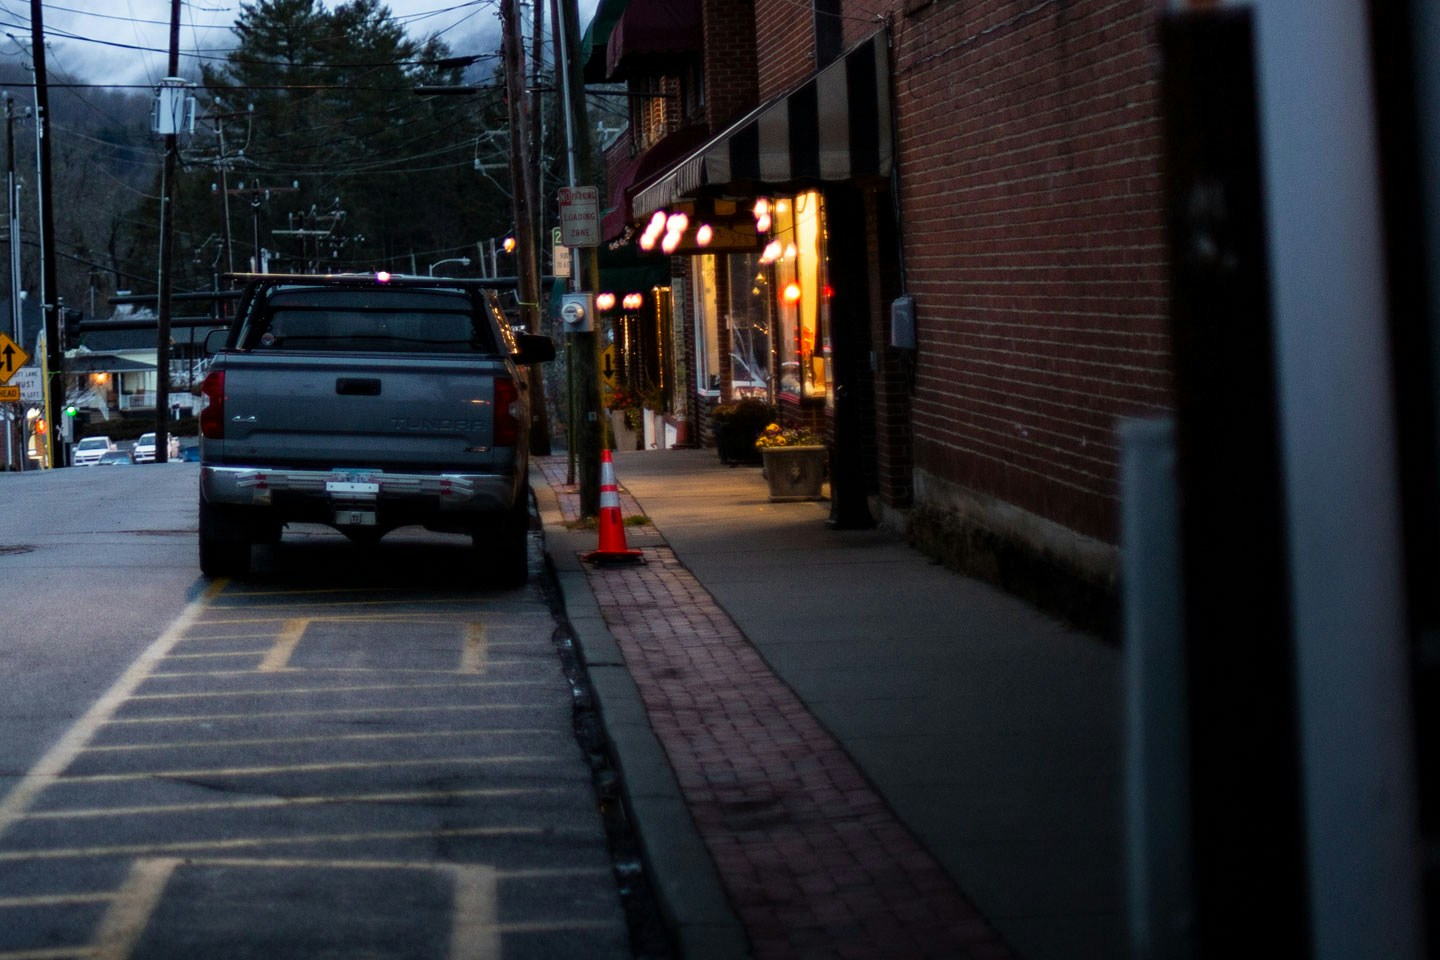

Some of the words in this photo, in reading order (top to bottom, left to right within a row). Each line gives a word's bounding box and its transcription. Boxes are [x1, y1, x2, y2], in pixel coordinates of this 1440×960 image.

[559, 191, 571, 203] NO
[571, 191, 596, 201] PARKING
[563, 212, 596, 222] LOADING
[571, 228, 590, 238] ZONE
[391, 417, 487, 432] TUNDRA
